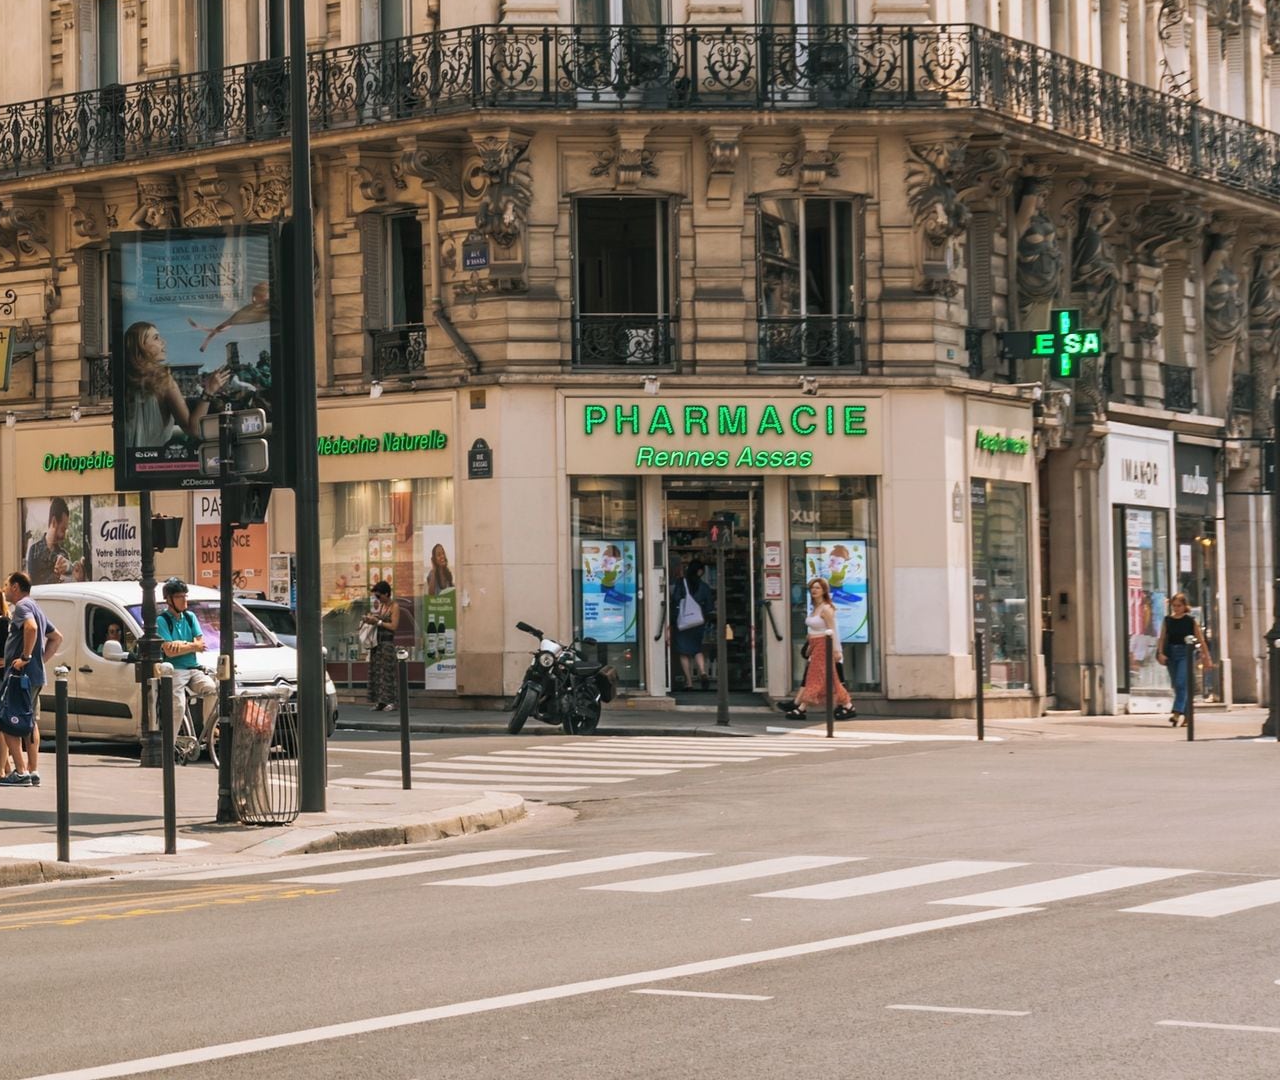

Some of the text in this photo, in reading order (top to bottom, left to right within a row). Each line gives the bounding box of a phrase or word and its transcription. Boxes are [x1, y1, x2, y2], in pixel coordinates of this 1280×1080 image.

[156, 274, 236, 290] LONGINES
[584, 404, 868, 436] PHARMACIE
[382, 429, 448, 452] Naturelle
[43, 450, 115, 474] Orthopédie
[636, 446, 813, 467] Rennes Assas
[181, 478, 215, 487] JCDecaux
[201, 496, 224, 517] PA
[100, 520, 137, 542] Gallia
[96, 548, 113, 558] Votre
